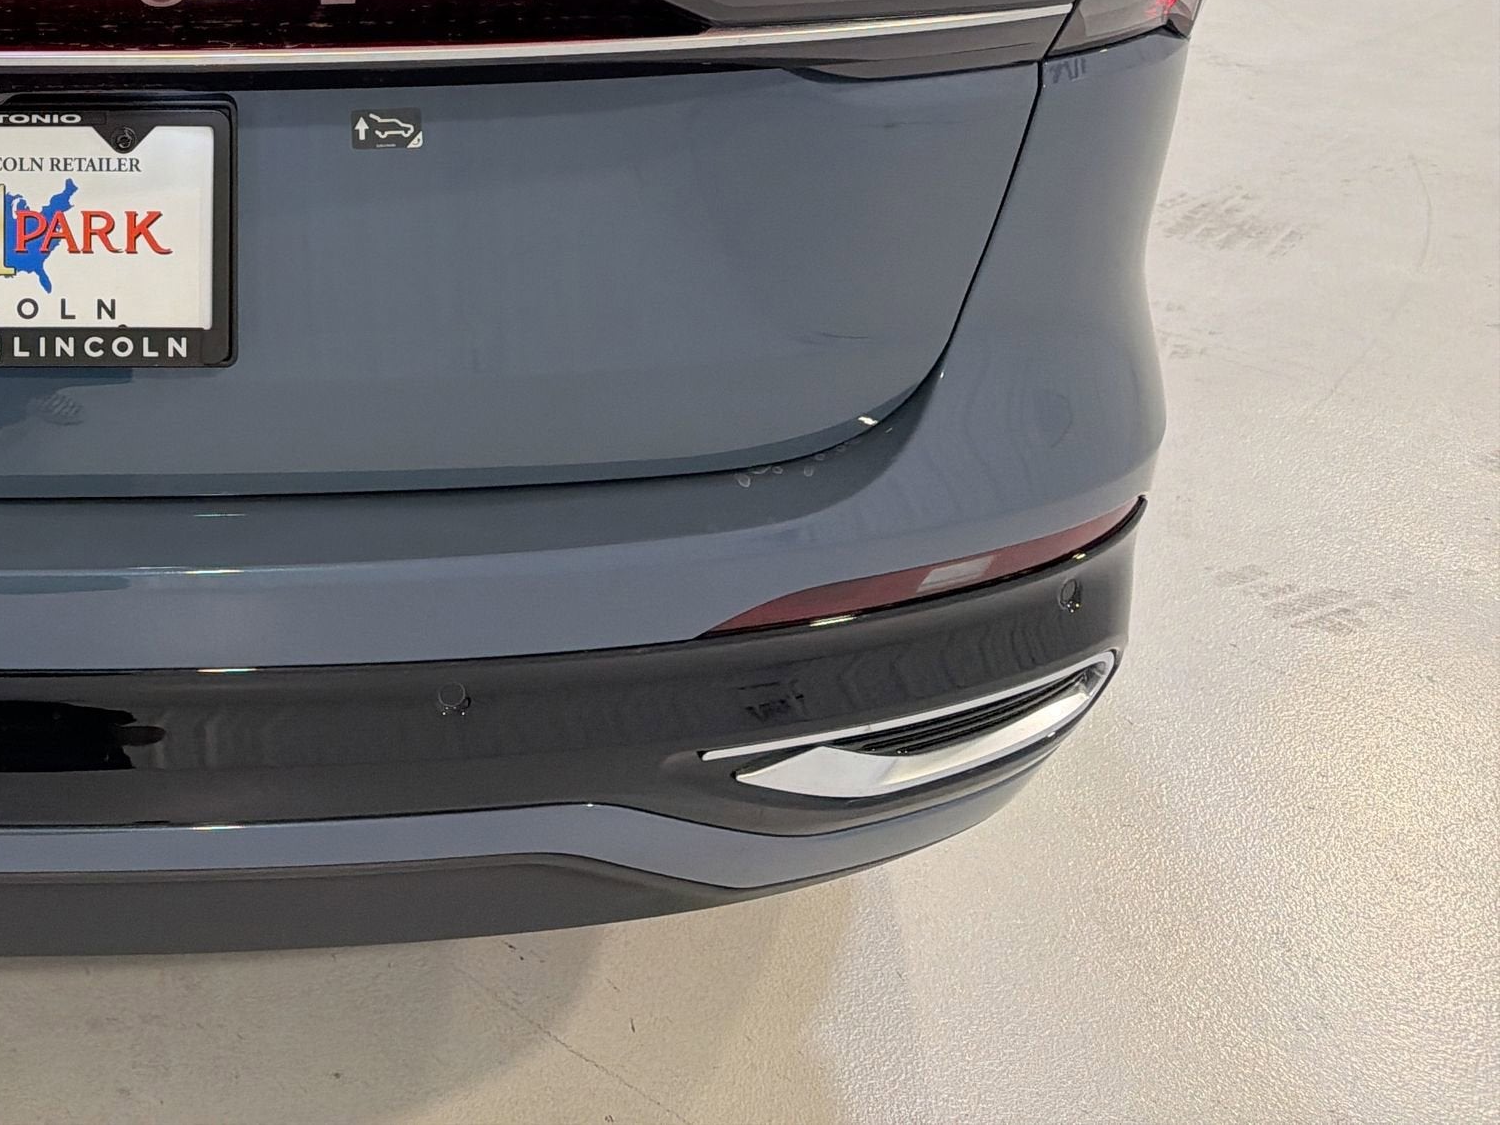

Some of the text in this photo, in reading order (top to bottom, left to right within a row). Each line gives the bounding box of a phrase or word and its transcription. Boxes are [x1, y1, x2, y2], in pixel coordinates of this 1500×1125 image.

[49, 156, 142, 173] RETAILER
[14, 209, 174, 255] PARK
[13, 336, 188, 358] LINCOLN
